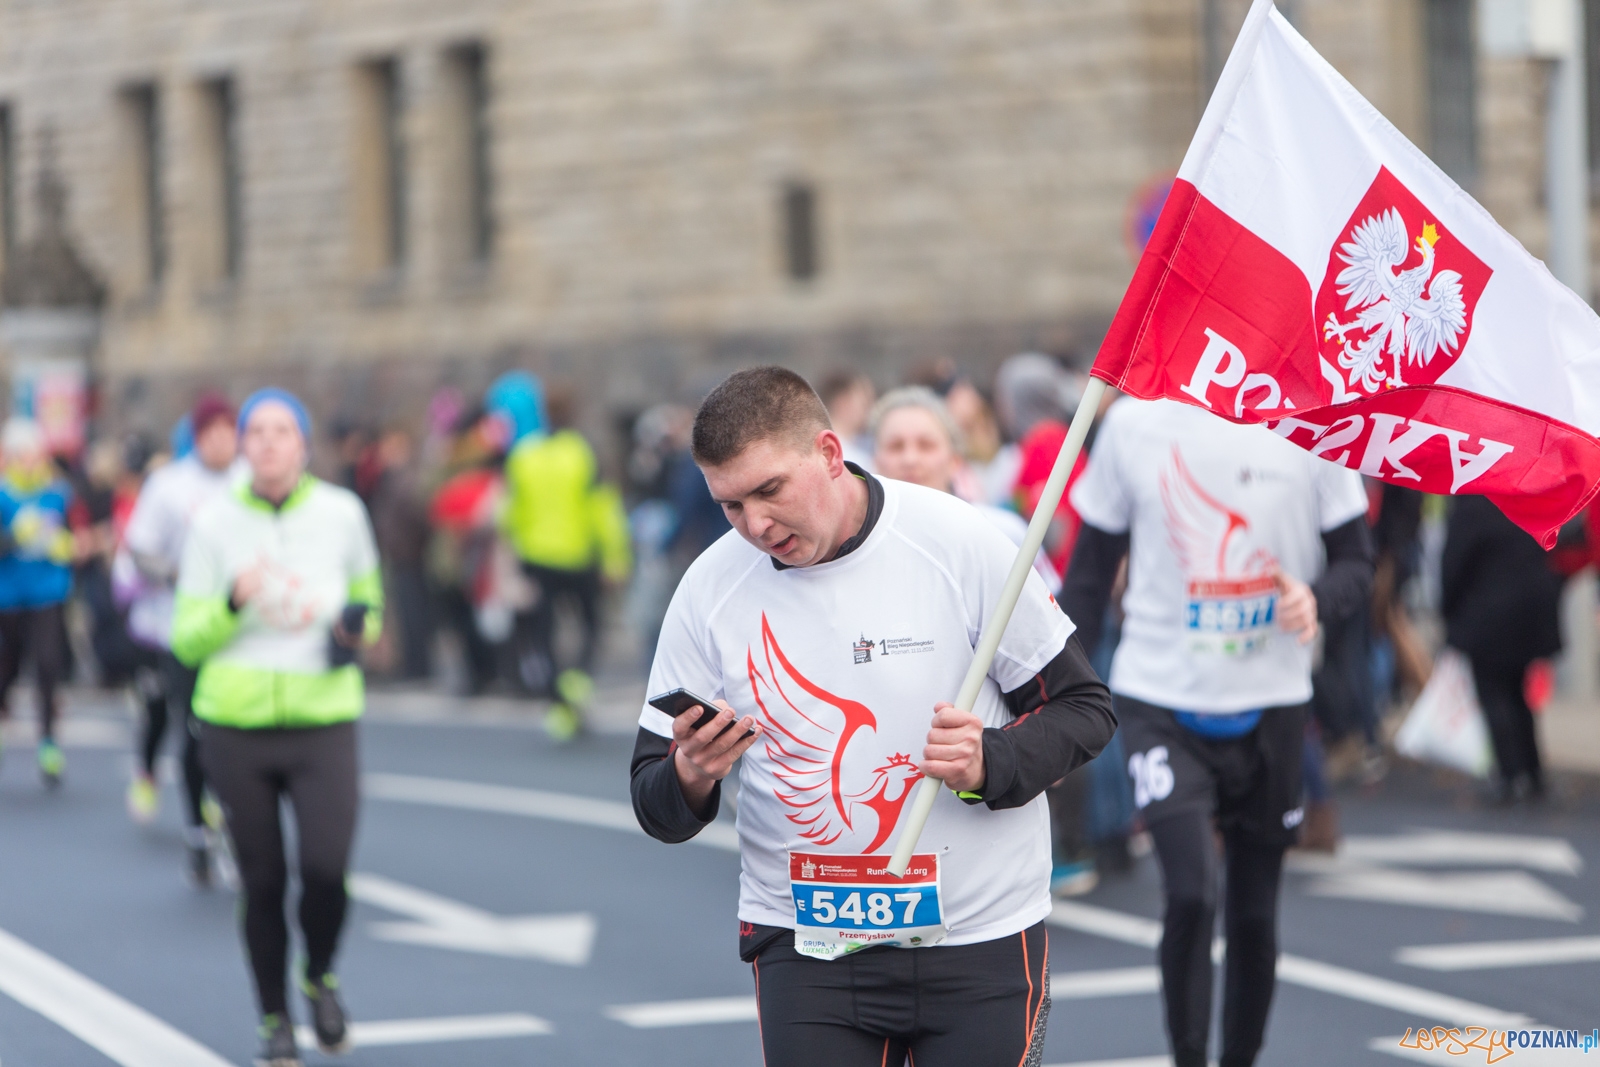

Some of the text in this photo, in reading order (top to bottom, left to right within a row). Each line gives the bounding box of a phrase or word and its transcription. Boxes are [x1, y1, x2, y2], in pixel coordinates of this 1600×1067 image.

[879, 639, 889, 655] 1
[866, 867, 928, 876] RunPd.org
[797, 890, 922, 926] E 5487
[839, 931, 895, 941] Przemysław
